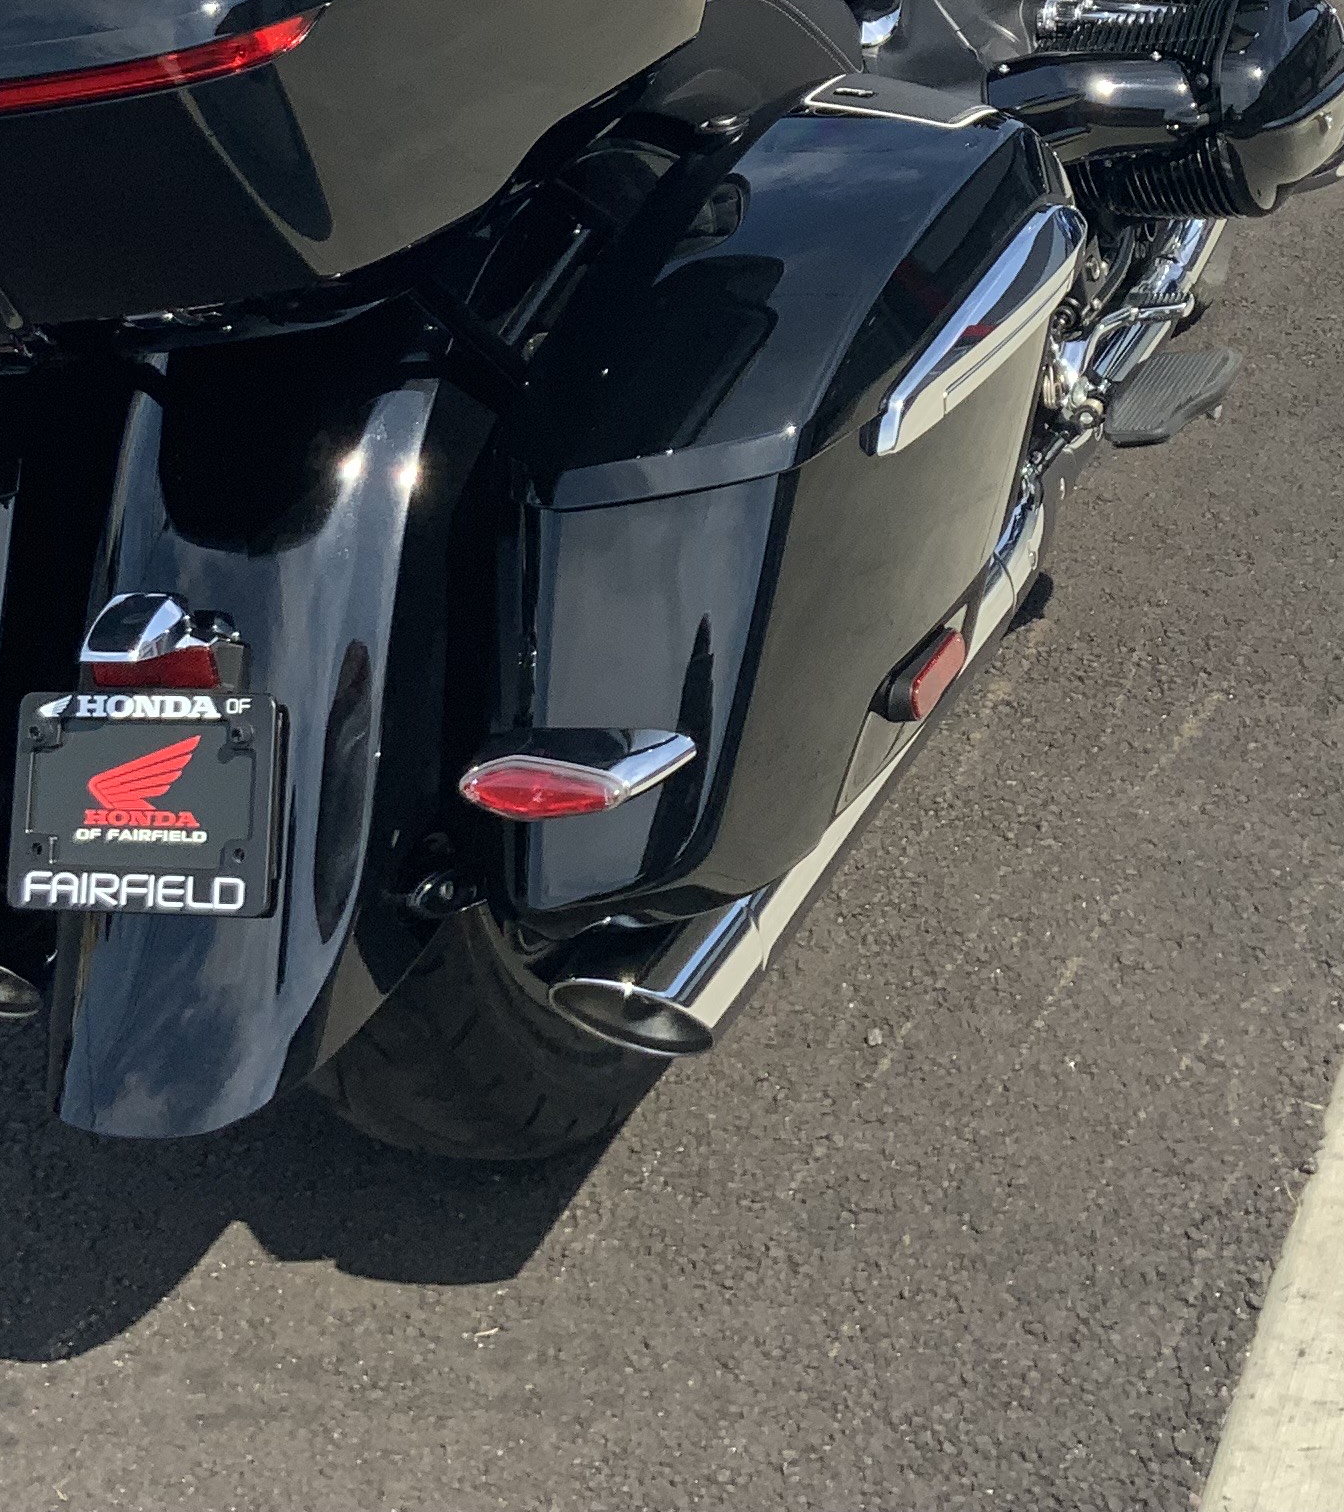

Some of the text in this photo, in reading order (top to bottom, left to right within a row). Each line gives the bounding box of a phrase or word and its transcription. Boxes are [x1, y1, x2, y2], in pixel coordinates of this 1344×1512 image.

[76, 694, 252, 719] HONDA OF
[83, 808, 200, 828] HONDA
[75, 828, 208, 844] OF FAIRFIELD
[22, 869, 246, 911] FAIRFIELD
